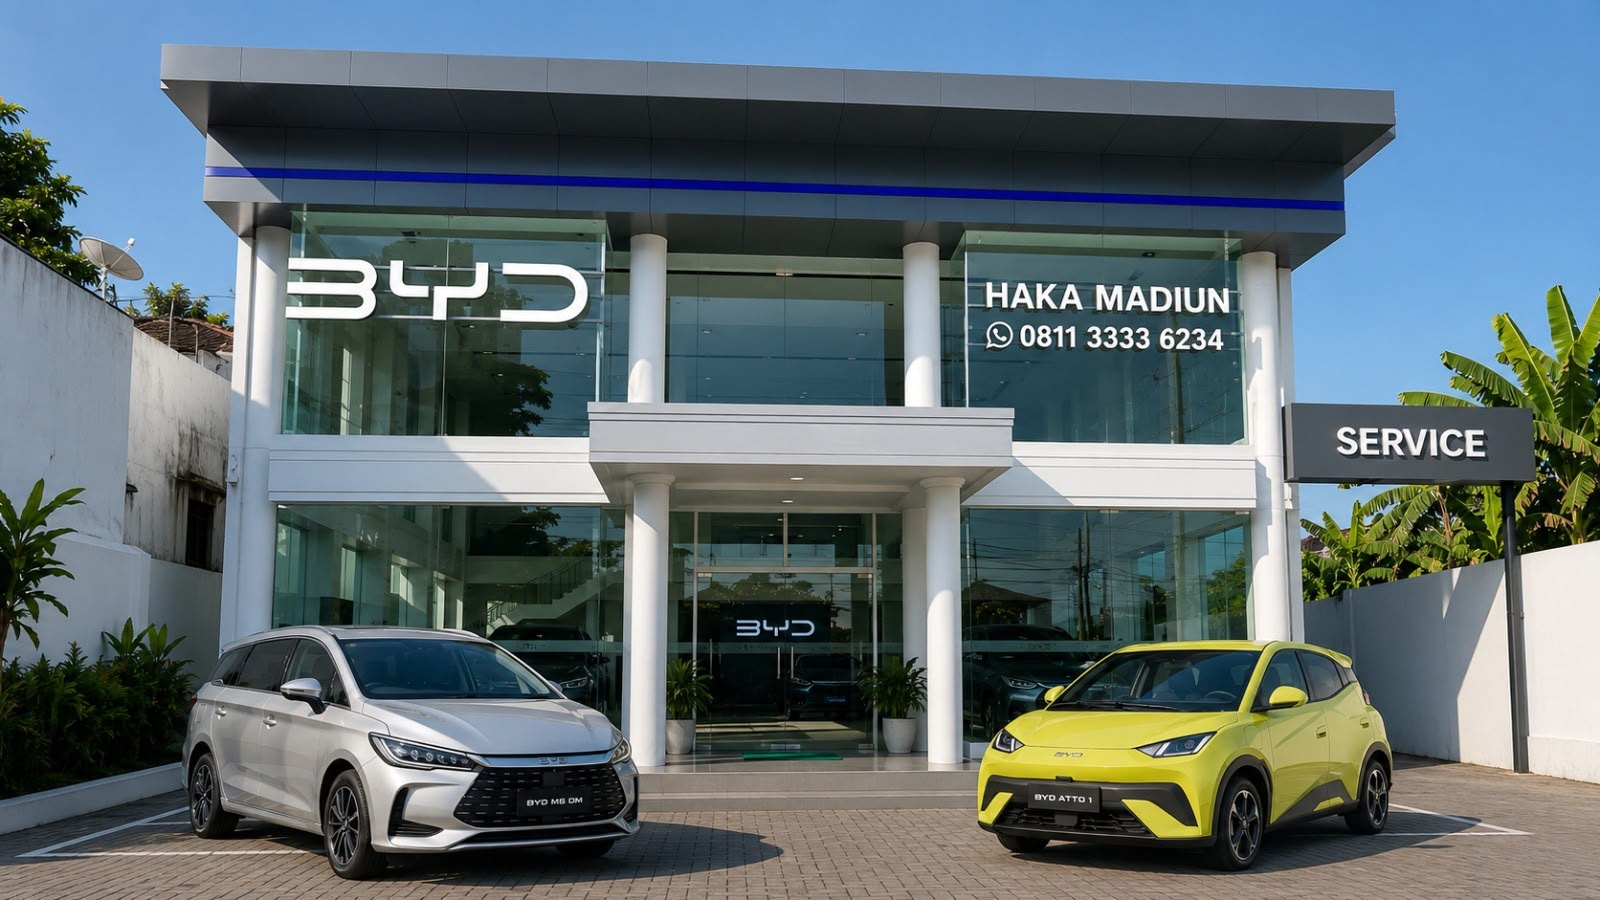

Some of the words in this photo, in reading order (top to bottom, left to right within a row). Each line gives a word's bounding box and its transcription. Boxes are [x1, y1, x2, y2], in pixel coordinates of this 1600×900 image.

[285, 257, 588, 322] BYD
[985, 281, 1084, 311] HAKA
[1095, 284, 1230, 314] MADIUN
[1019, 324, 1077, 348] 0811
[1086, 326, 1151, 350] 3333
[1159, 328, 1224, 351] 6234
[1336, 426, 1486, 457] SERVICE
[736, 619, 815, 637] BYD
[526, 799, 548, 807] BYD
[568, 796, 583, 804] DM
[1034, 793, 1056, 802] BYD
[1058, 795, 1086, 803] ATTO
[1088, 796, 1093, 804] 1
